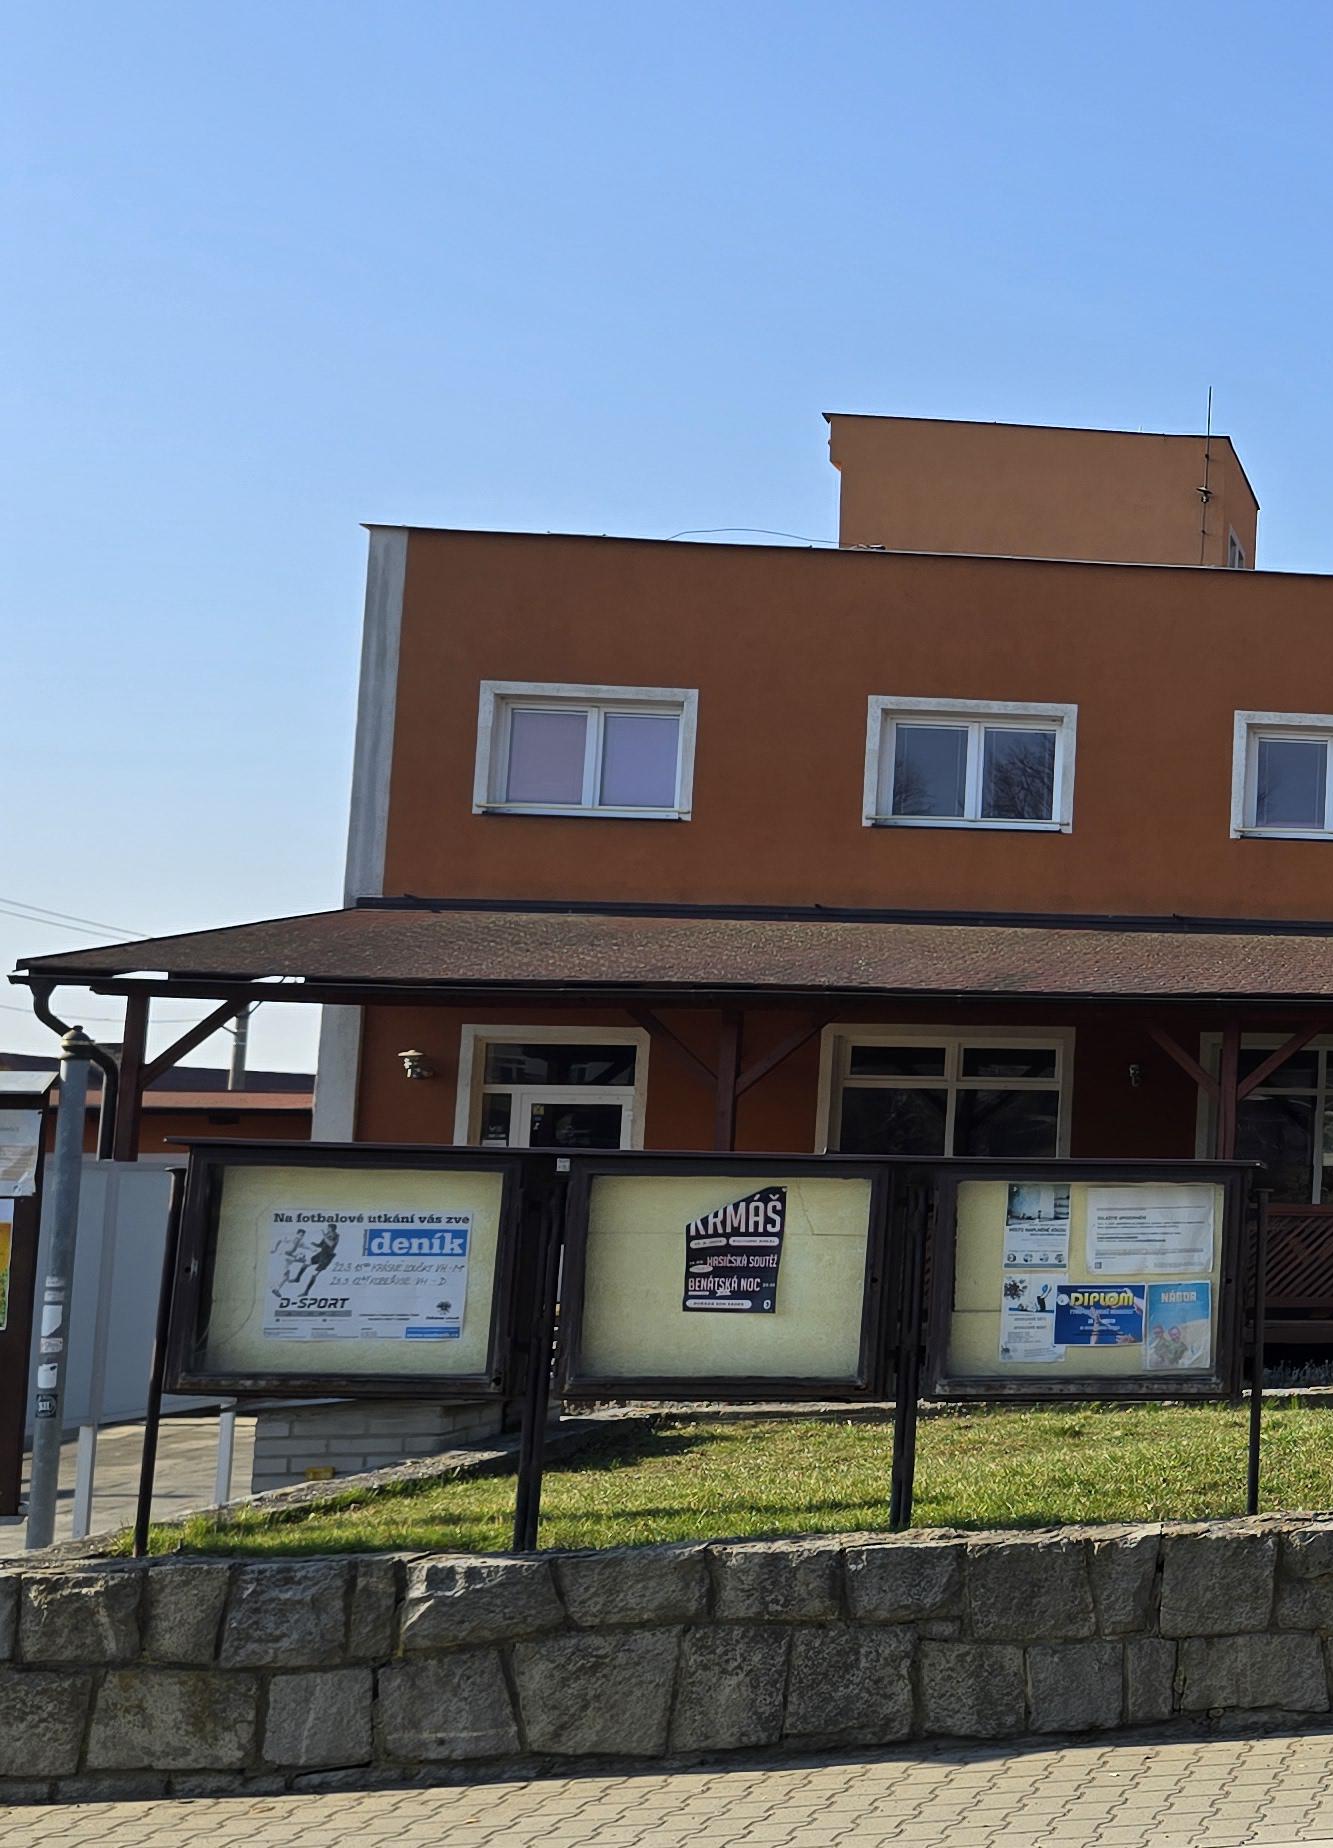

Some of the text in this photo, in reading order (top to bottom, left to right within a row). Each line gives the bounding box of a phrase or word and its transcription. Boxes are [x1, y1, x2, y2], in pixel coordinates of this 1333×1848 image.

[273, 1212, 470, 1225] Na fotbalové utkání vás zve
[370, 1232, 465, 1254] deník
[706, 1253, 778, 1268] HASIČSKÁ SOUTĚŽ
[688, 1274, 738, 1291] BENÁTSKÁ
[740, 1277, 761, 1291] NOC
[278, 1297, 351, 1309] D-SPORT
[1070, 1291, 1134, 1307] DIPLOM
